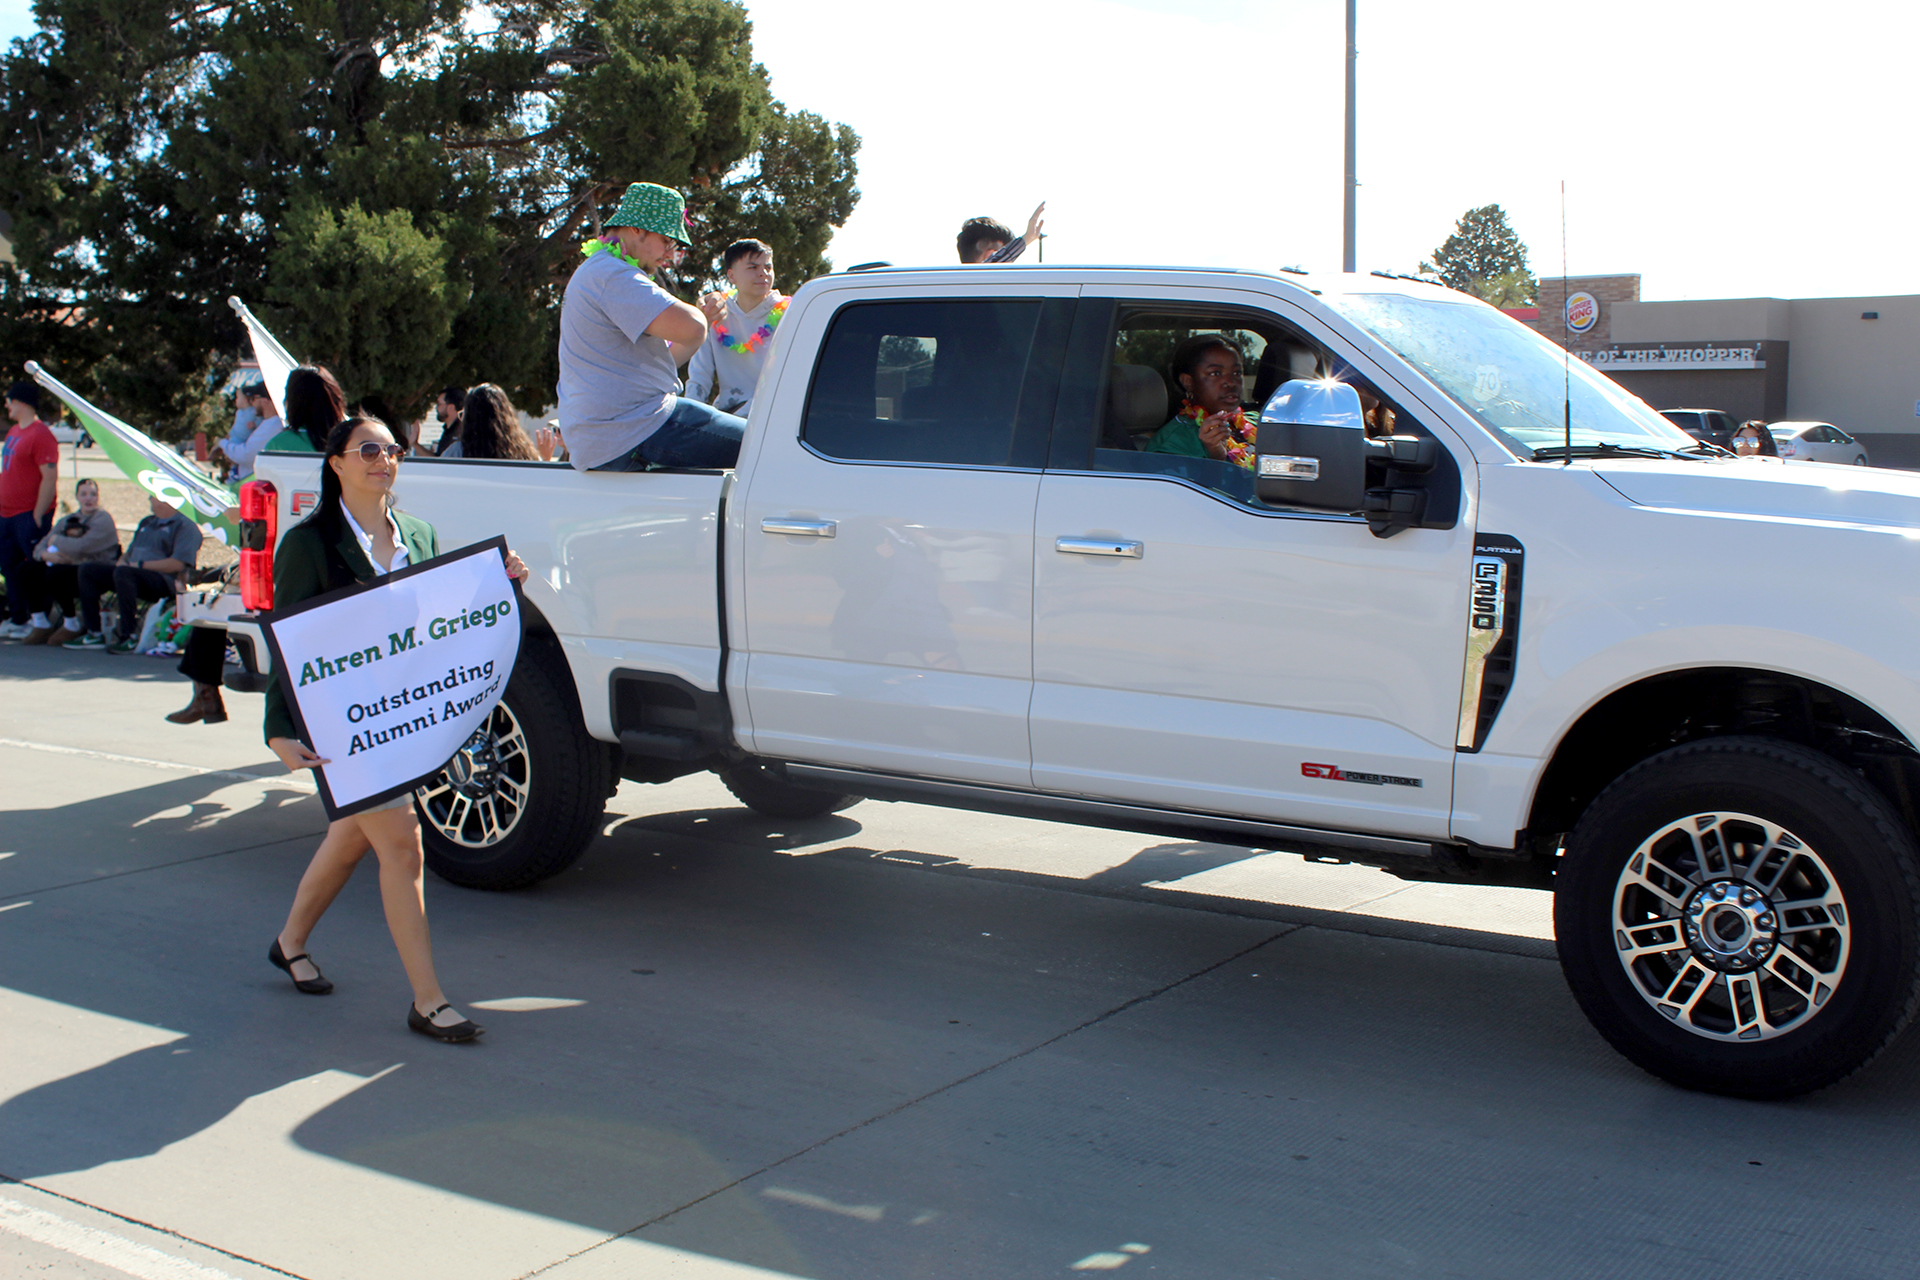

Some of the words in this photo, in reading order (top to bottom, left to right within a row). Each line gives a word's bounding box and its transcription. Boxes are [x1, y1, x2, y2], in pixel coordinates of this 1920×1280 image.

[1568, 300, 1592, 315] BURGER
[1569, 306, 1593, 321] KING
[1596, 350, 1620, 363] OF
[1622, 350, 1660, 363] THE
[1478, 372, 1497, 393] 70
[1475, 546, 1522, 554] PLATINUM
[299, 645, 383, 687] Ahren
[388, 626, 424, 656] M.
[429, 600, 511, 640] Griego
[347, 660, 495, 723] Outstanding
[348, 707, 438, 757] Alumni
[442, 674, 502, 722] Award
[1301, 762, 1345, 781] 6.7L
[1346, 771, 1379, 783] POWER
[1381, 775, 1420, 787] STROKE
